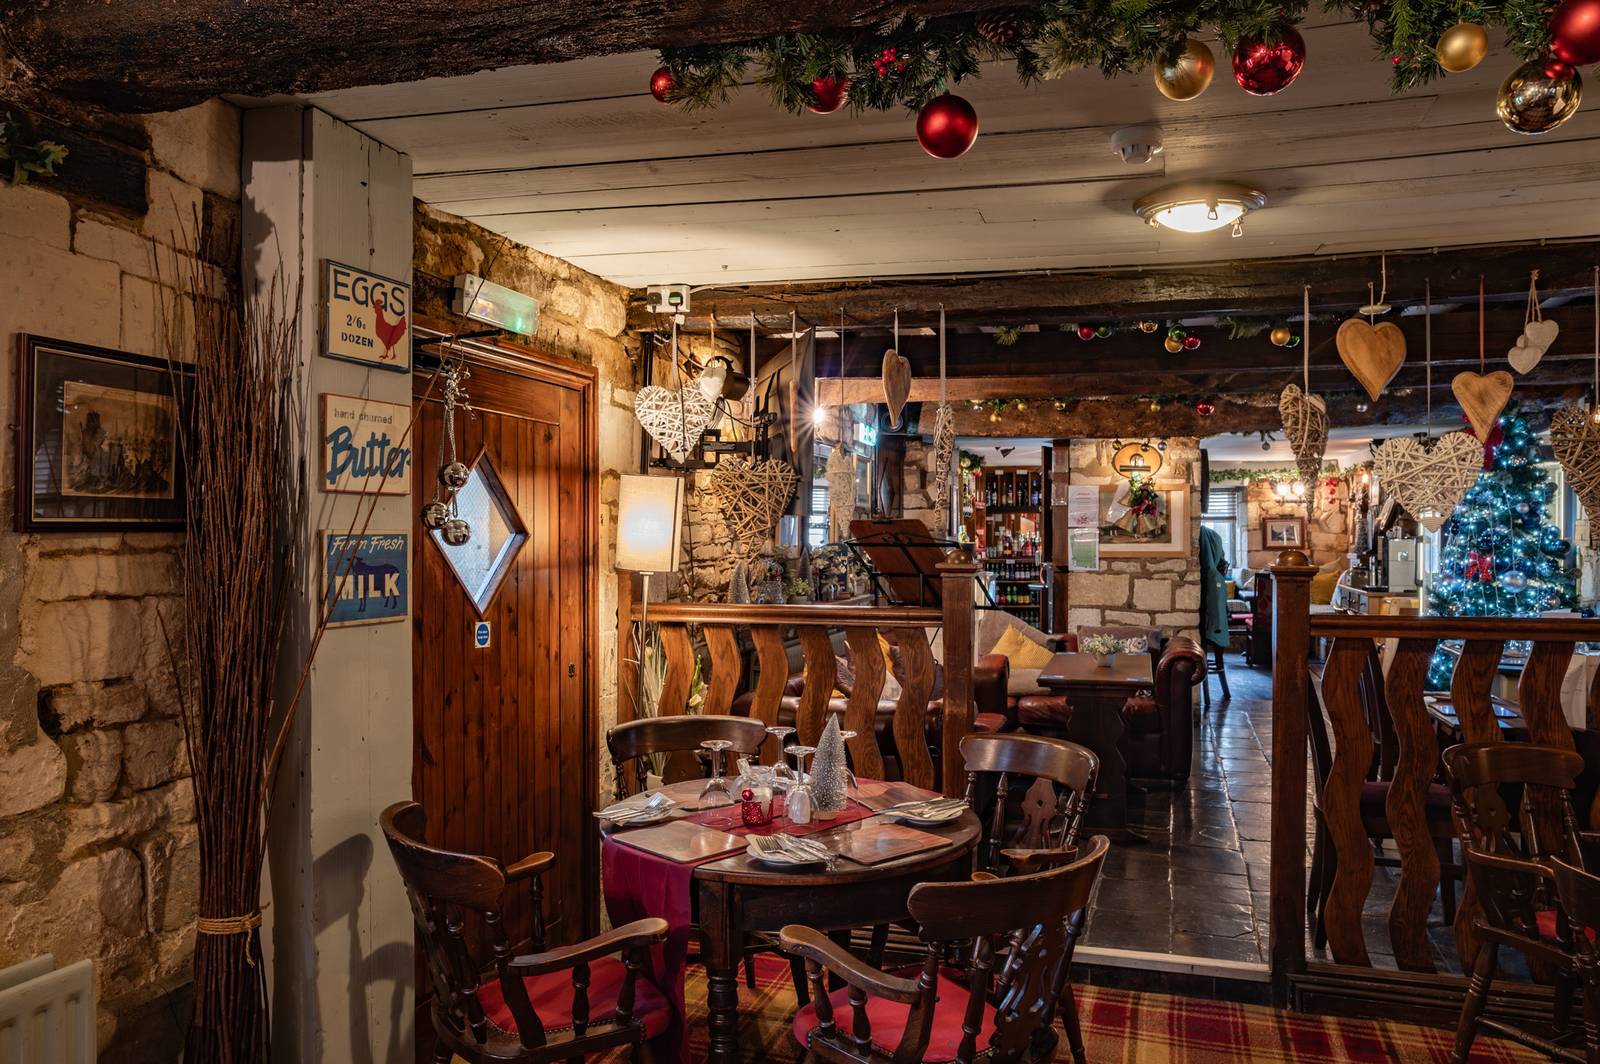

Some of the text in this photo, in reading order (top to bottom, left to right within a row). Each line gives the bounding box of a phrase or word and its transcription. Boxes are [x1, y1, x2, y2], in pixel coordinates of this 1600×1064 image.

[333, 268, 405, 317] EGGS
[341, 331, 374, 348] DOZEN
[334, 407, 355, 420] hand
[326, 425, 411, 485] Butter
[369, 535, 404, 554] Fresh
[335, 572, 401, 601] MILK
